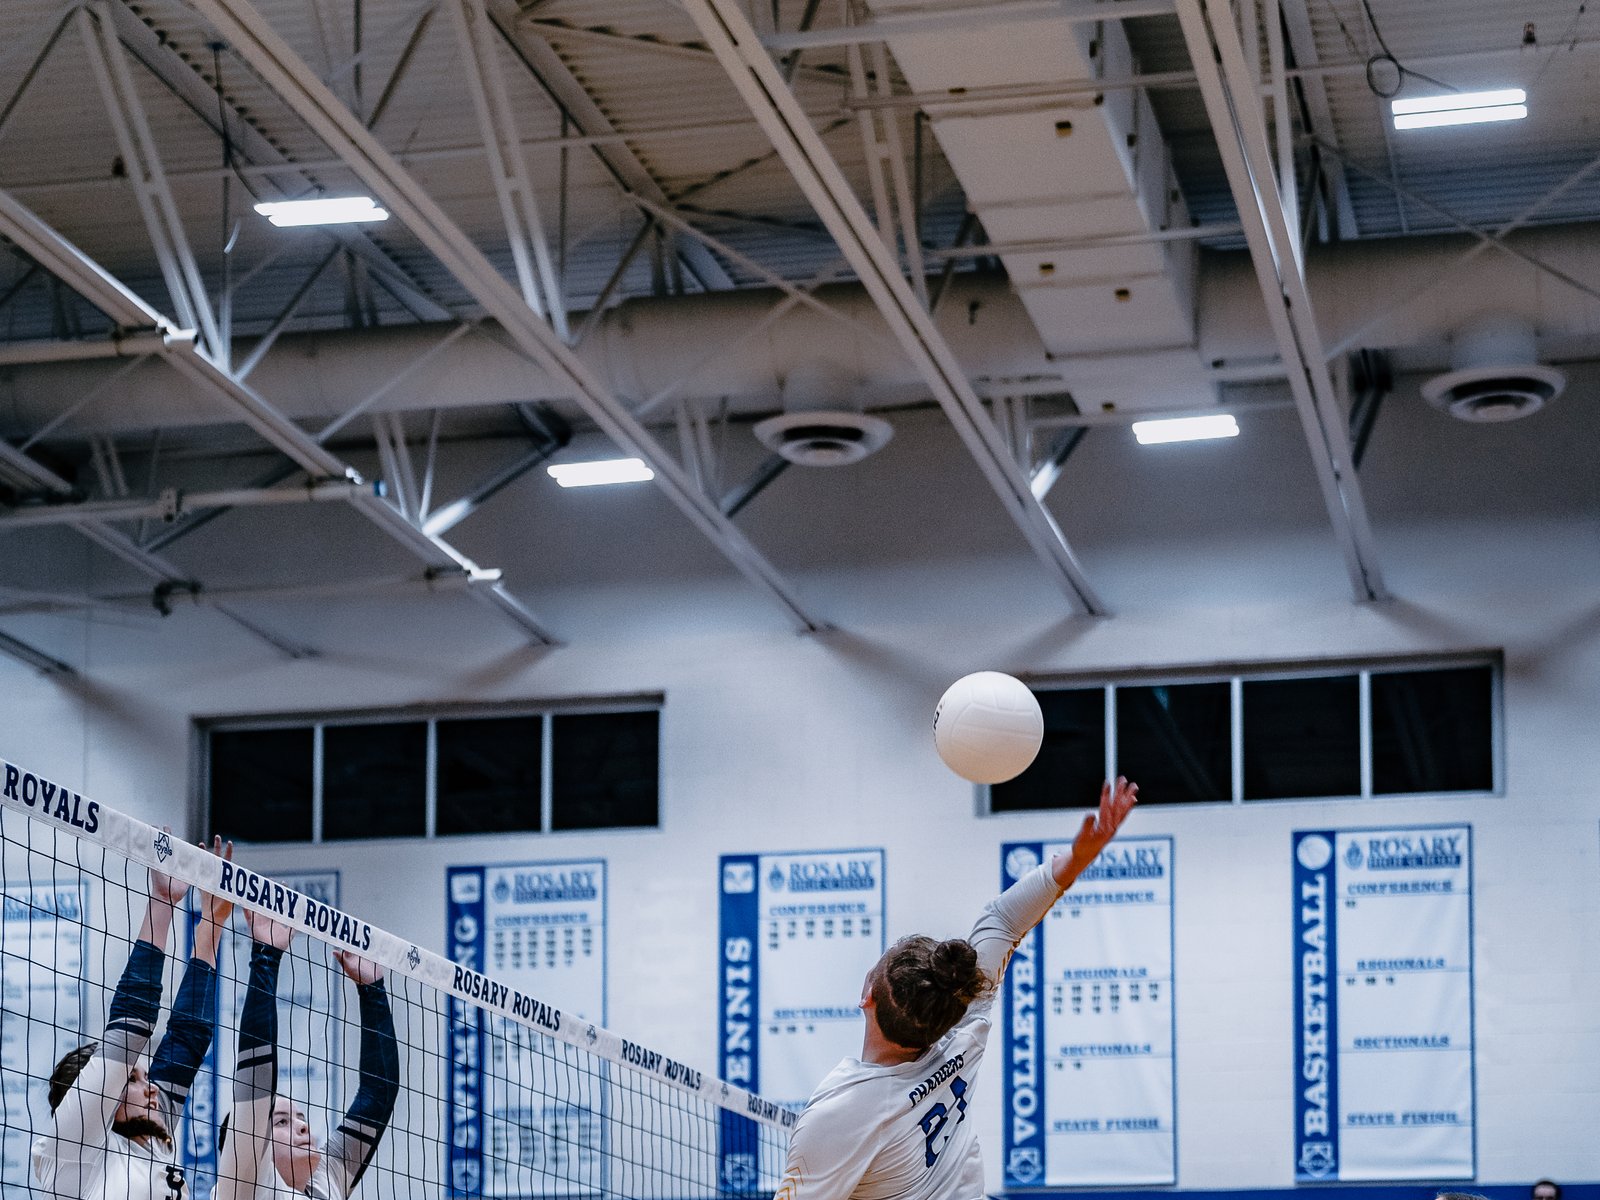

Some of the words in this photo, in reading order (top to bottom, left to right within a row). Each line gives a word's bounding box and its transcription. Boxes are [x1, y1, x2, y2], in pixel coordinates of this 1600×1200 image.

[3, 763, 100, 834] ROYALS
[789, 861, 874, 881] ROSARY
[1096, 848, 1162, 867] OSARY
[1367, 835, 1461, 857] ROSARY
[219, 861, 299, 920] ROSARY
[303, 898, 371, 951] ROYALS
[1056, 891, 1155, 905] ONFERENCE
[451, 914, 479, 1150] SWIMMNG
[453, 965, 508, 1009] ROSARY
[512, 991, 561, 1032] ROYALS
[725, 936, 751, 1086] ENNIS
[1302, 874, 1329, 1137] BASKETBALL
[621, 1039, 662, 1073] ROSARY
[664, 1058, 702, 1090] ROYALS
[1011, 932, 1037, 1146] VOLLEYBA
[747, 1093, 779, 1122] ROSARY
